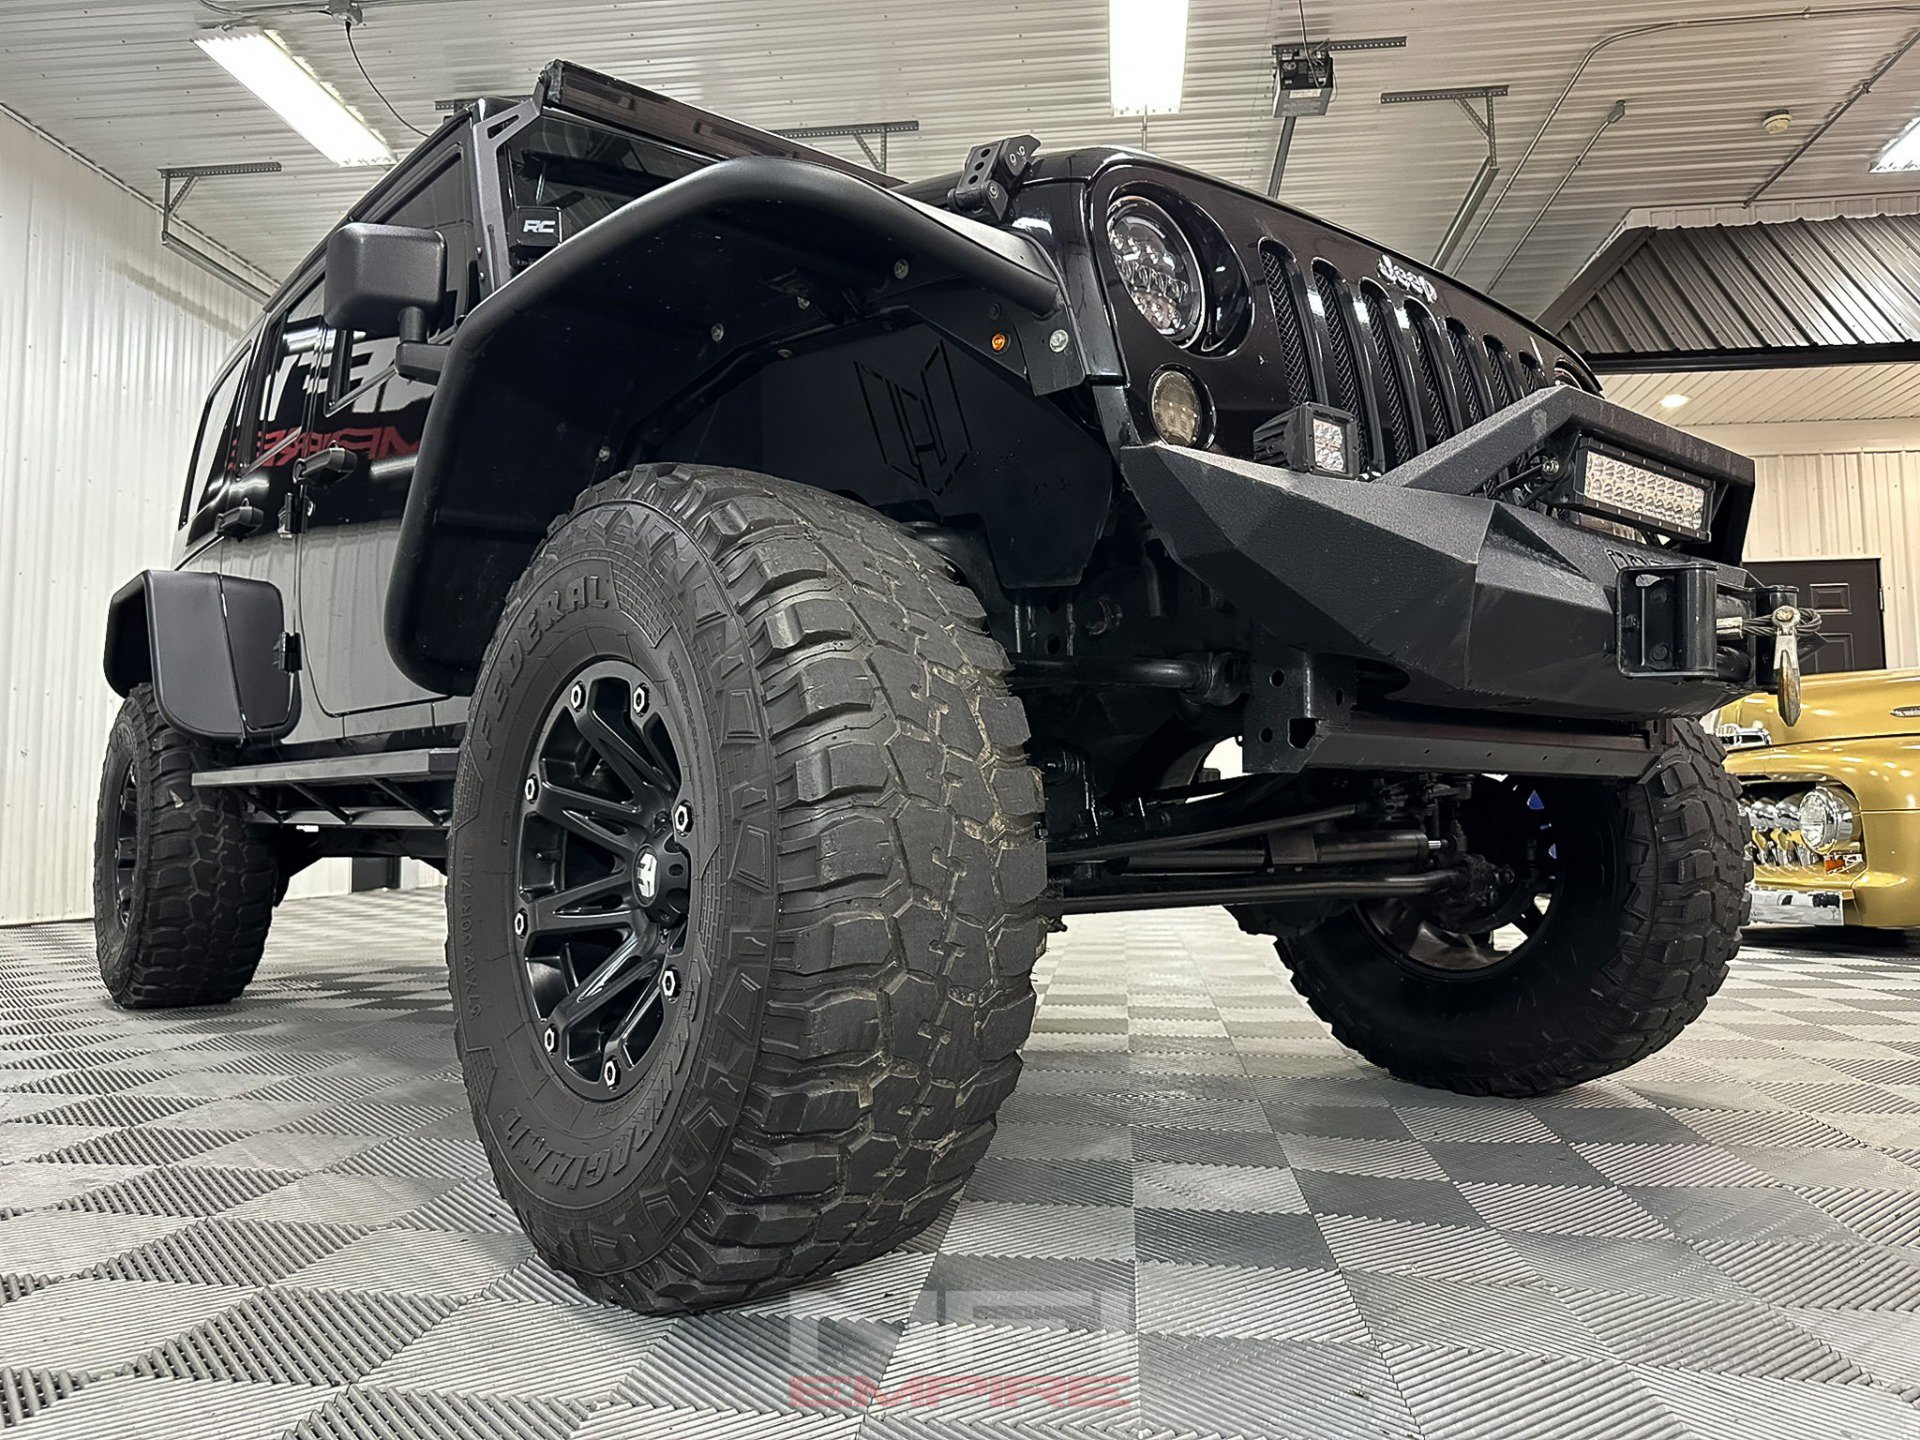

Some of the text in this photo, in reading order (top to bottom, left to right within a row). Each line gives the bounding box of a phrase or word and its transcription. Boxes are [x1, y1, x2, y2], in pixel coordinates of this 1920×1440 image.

[523, 219, 556, 233] RC
[1377, 254, 1438, 303] Jeep
[477, 575, 608, 761] FEDERAL
